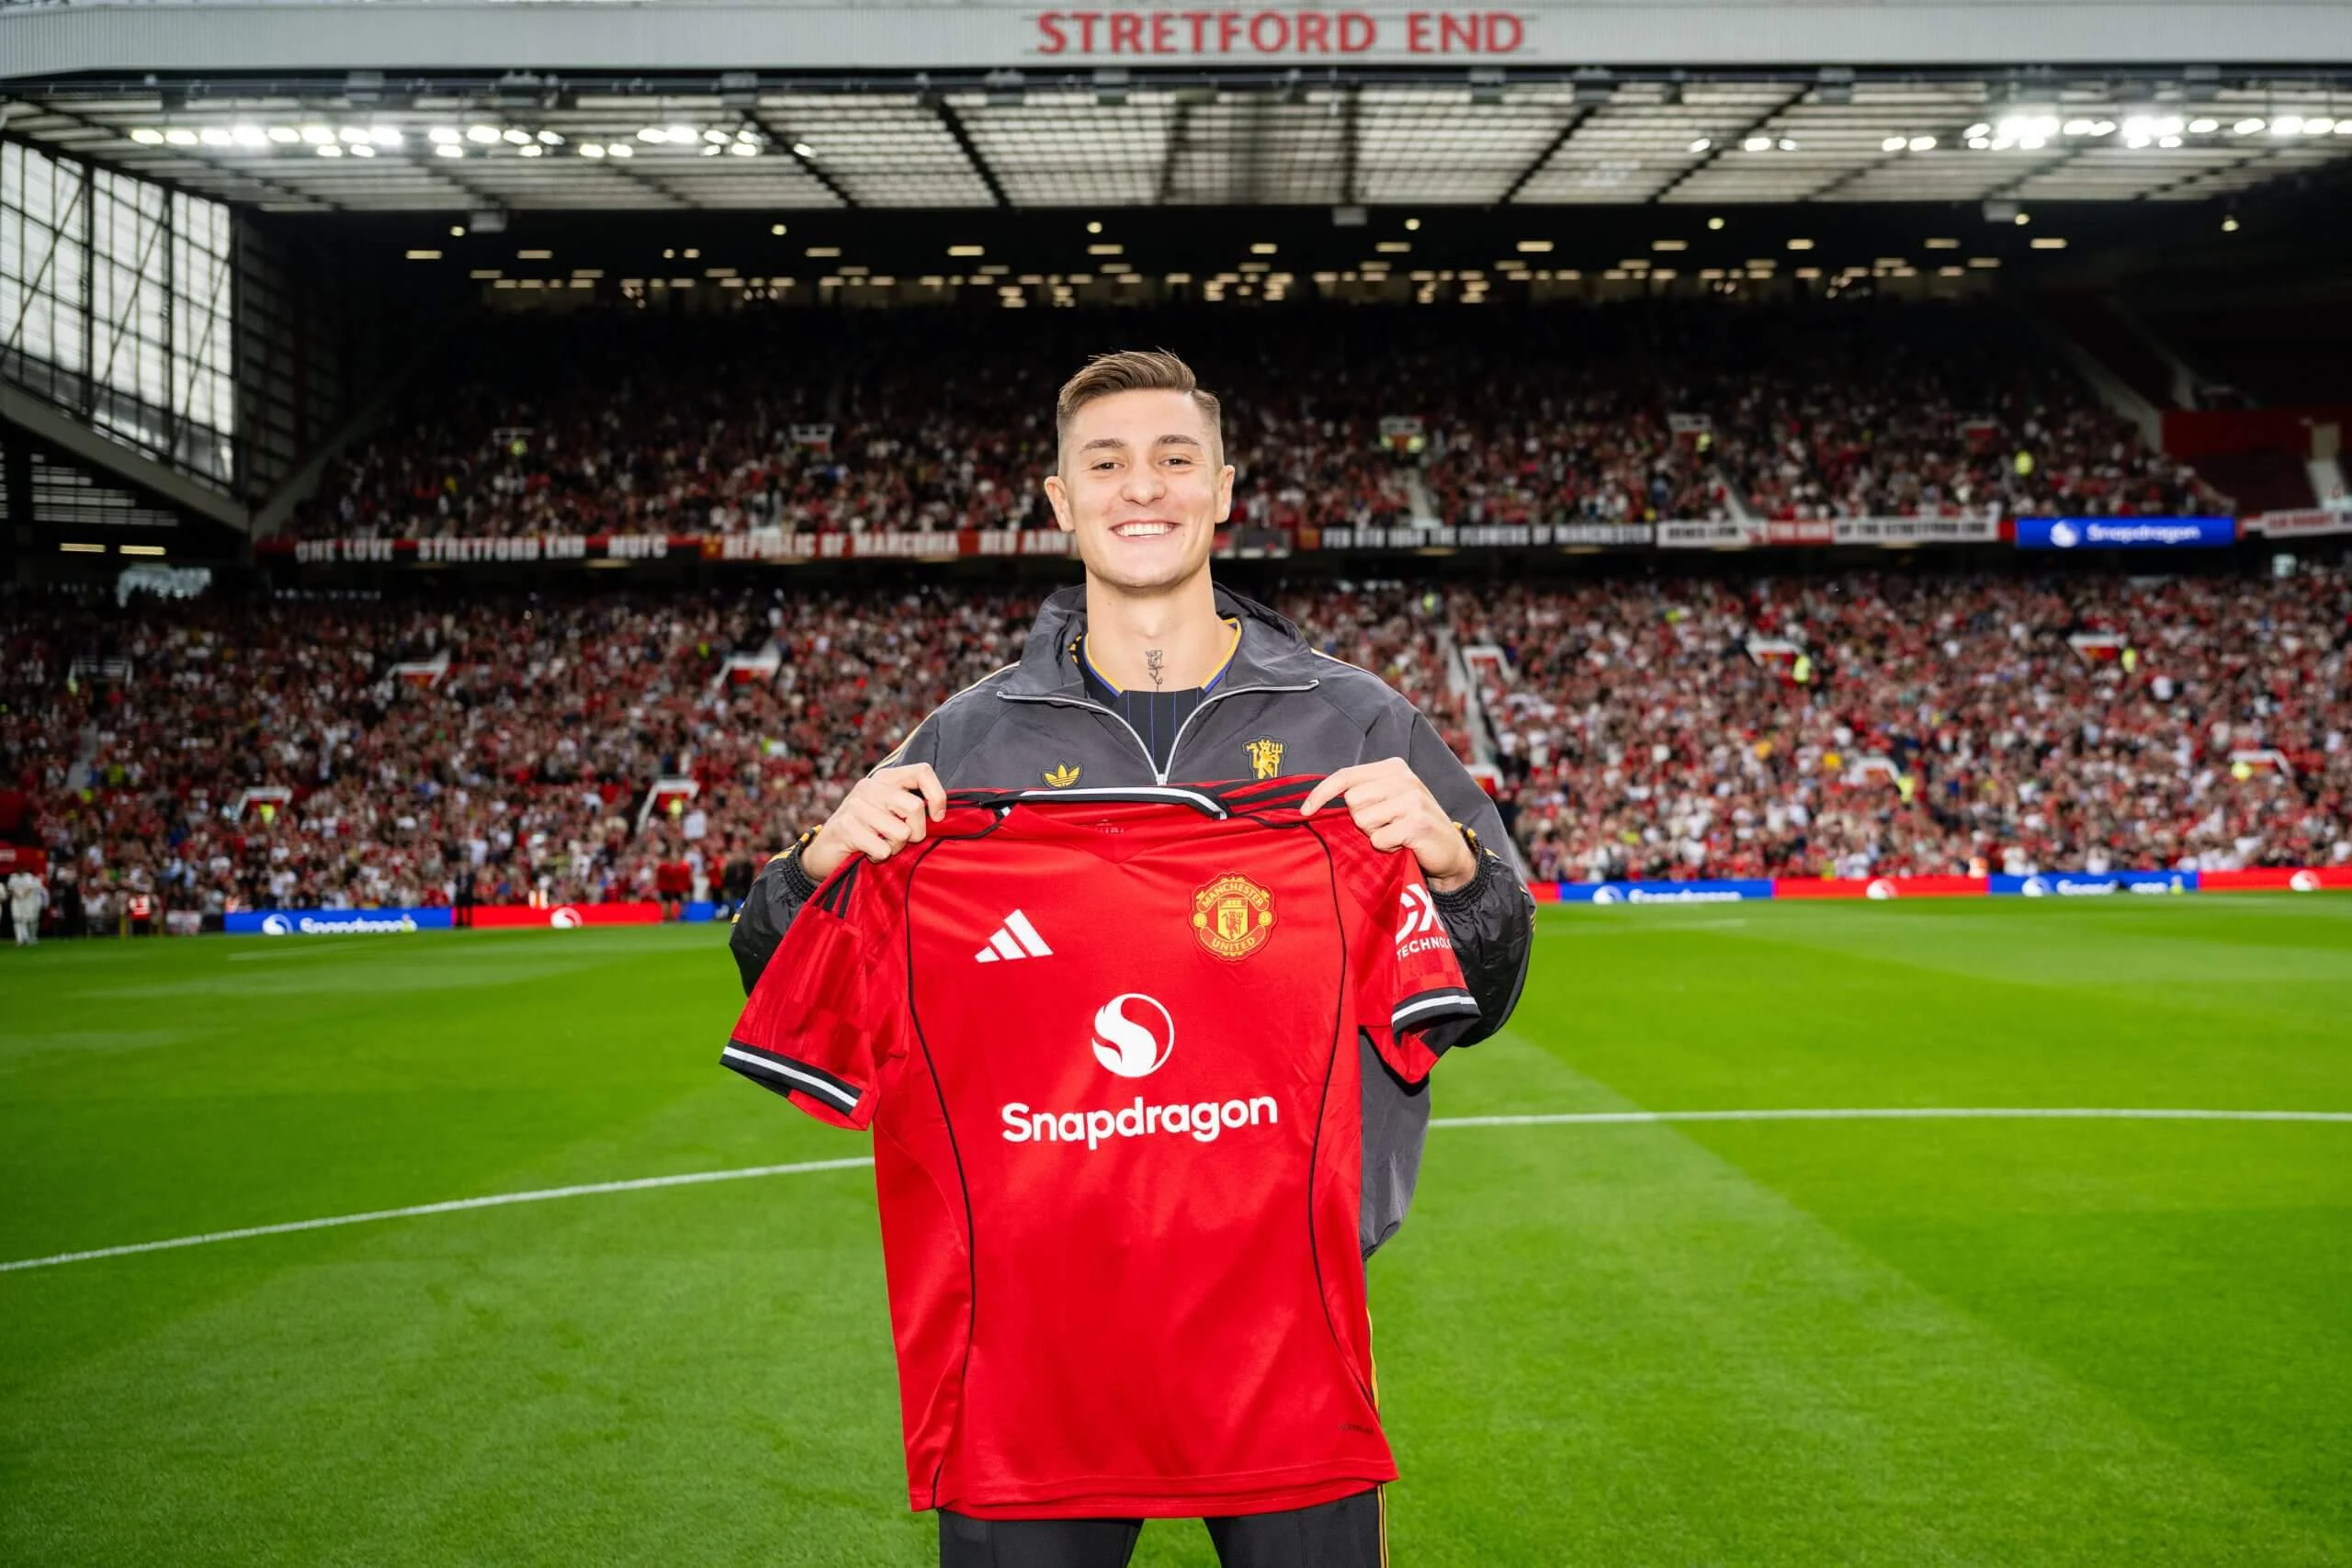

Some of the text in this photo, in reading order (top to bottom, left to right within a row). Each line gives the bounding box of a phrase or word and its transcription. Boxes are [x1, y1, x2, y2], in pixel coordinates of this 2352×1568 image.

[1036, 10, 1523, 53] STRETFORD END
[2086, 523, 2201, 545] Snapdragon
[1202, 883, 1264, 908] MANCHESTER
[1212, 936, 1256, 952] UNITED
[1001, 1096, 1278, 1150] Snapdragon
